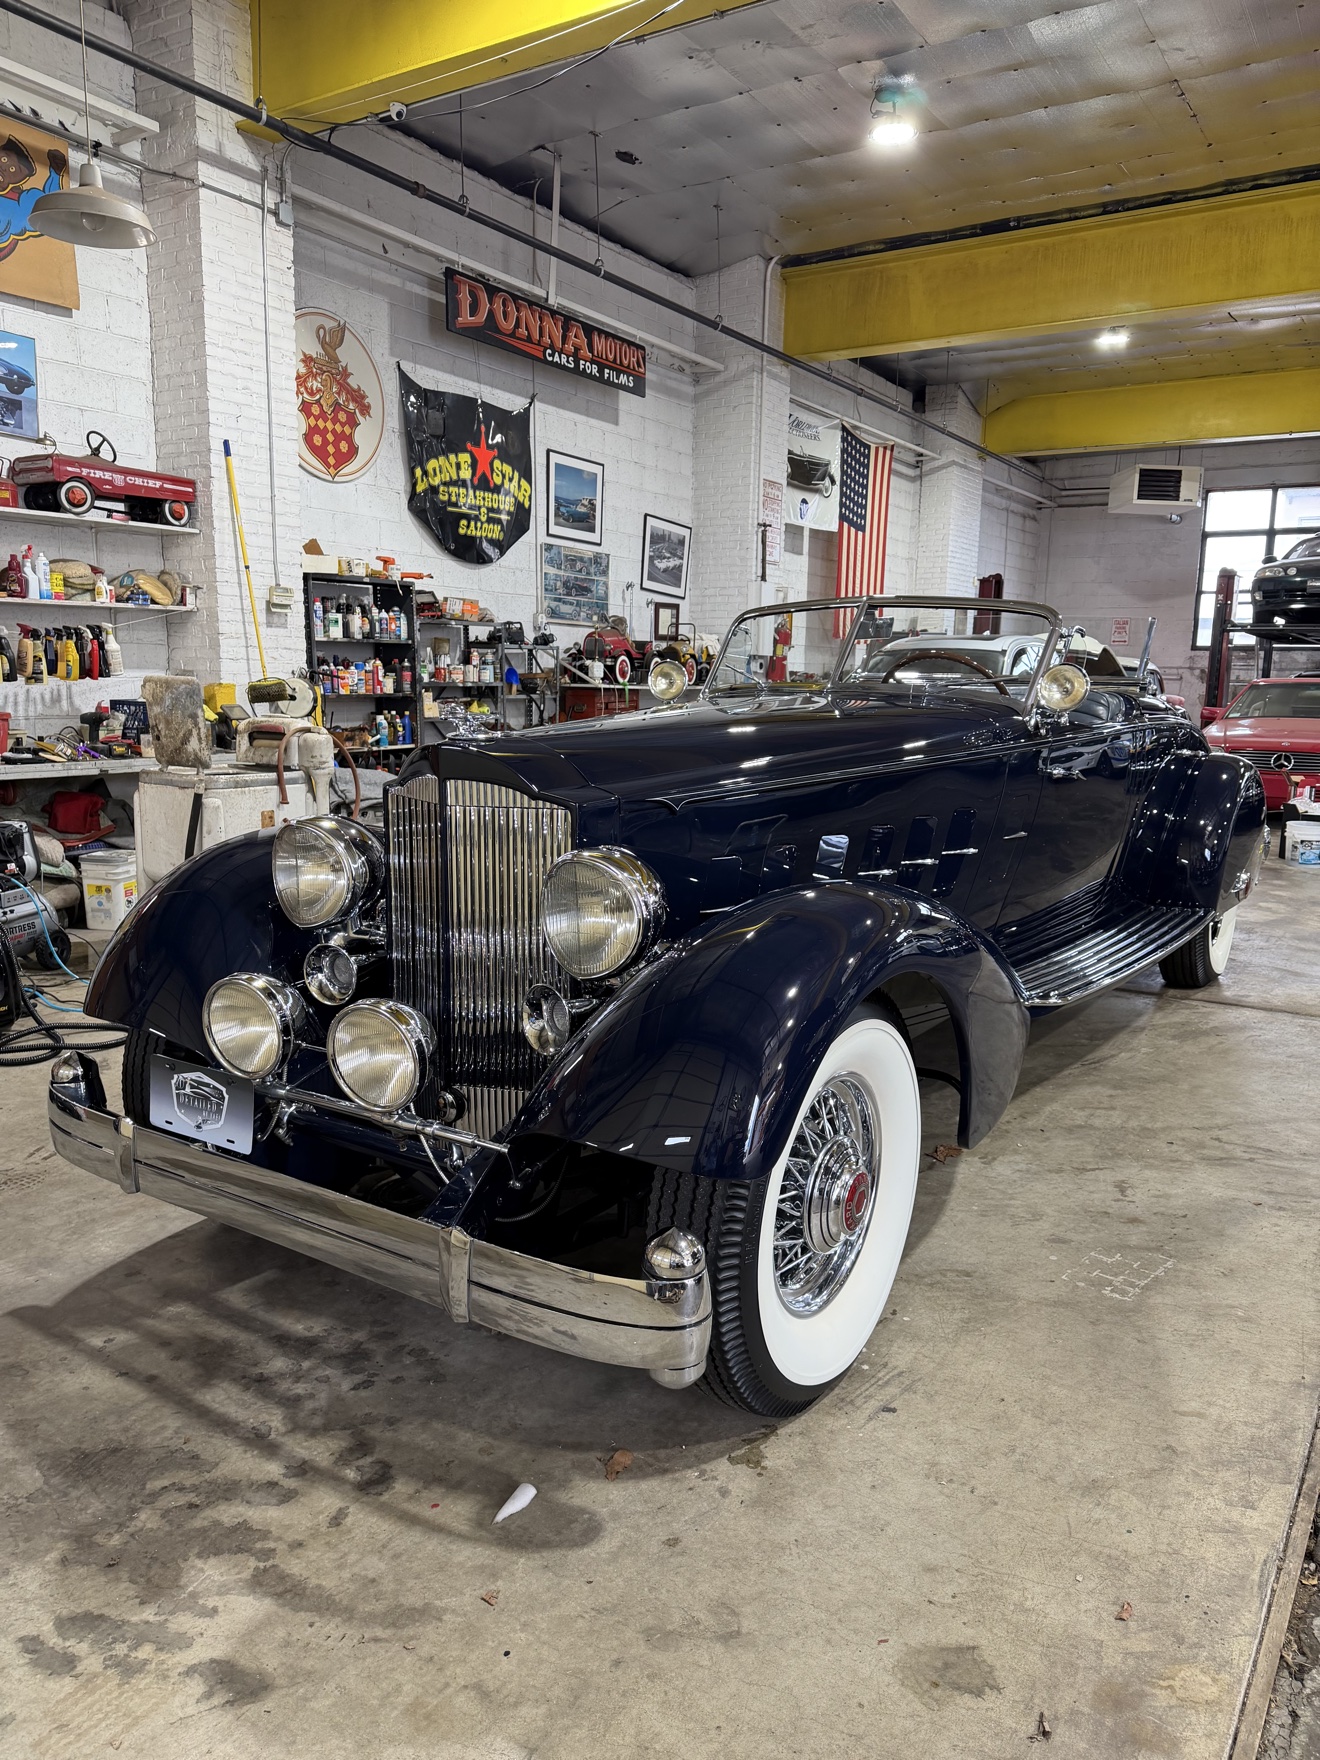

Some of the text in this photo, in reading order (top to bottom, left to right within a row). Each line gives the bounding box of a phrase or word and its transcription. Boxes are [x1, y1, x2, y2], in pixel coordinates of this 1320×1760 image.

[453, 274, 646, 374] DONNA MOTORS
[545, 349, 634, 387] CARS FOR FILMS
[80, 467, 113, 480] FIRE
[126, 476, 162, 488] CHIEF
[413, 452, 531, 509] LONE STAR
[438, 485, 515, 512] STEAKHOUSE
[6, 921, 36, 935] RTRESS
